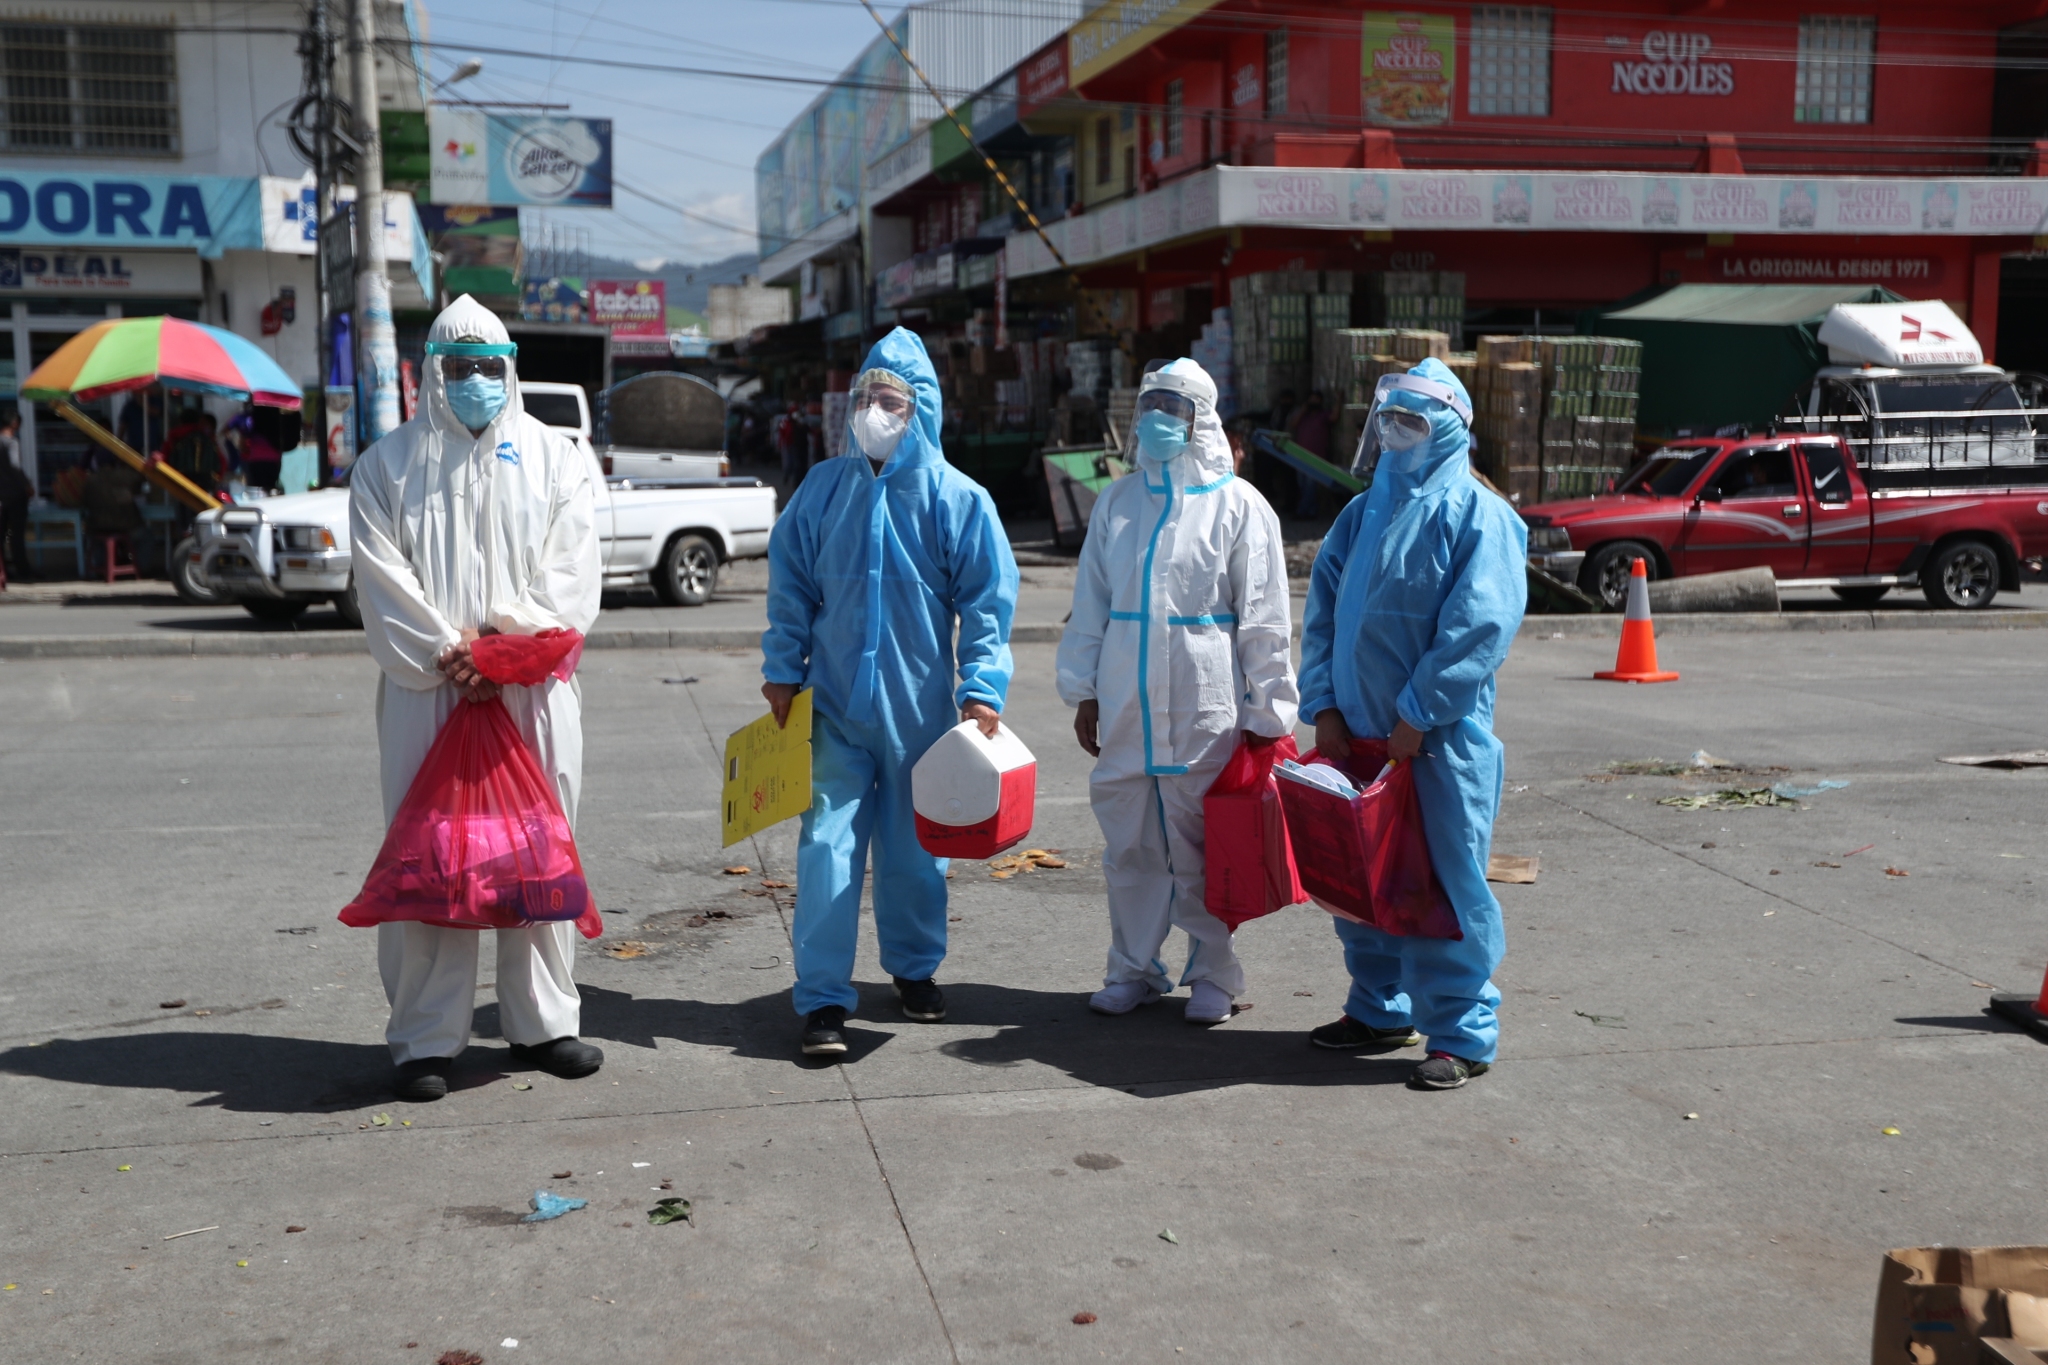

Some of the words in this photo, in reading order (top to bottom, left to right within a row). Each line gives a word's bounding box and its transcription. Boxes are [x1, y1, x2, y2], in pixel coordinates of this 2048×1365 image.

[1389, 35, 1429, 52] CUP
[1642, 30, 1712, 61] CUP
[1374, 51, 1442, 69] NOODLES
[1611, 61, 1734, 96] NOODLES
[519, 161, 573, 179] Seltzer
[1275, 176, 1323, 199] CUP
[1420, 178, 1466, 200] CUP
[1573, 179, 1617, 200] CUP
[1711, 181, 1755, 202] CUP
[1856, 185, 1898, 205] CUP
[1988, 185, 2030, 205] CUP
[1258, 195, 1337, 219] NOODLES
[1402, 196, 1481, 220] NOODLES
[1554, 197, 1631, 221] NOODLES
[1693, 200, 1769, 224] NOODLES
[1838, 203, 1911, 225] NOODLES
[1970, 203, 2043, 226] NOODLES
[1389, 250, 1435, 271] CUP
[1723, 258, 1744, 277] LA
[1749, 258, 1835, 278] ORIGINAL
[1838, 258, 1892, 278] DESDE
[1895, 259, 1929, 278] 1971
[594, 286, 661, 312] tabcin
[1902, 352, 1955, 364] MITSUBISHI
[1956, 352, 1977, 364] FUSO
